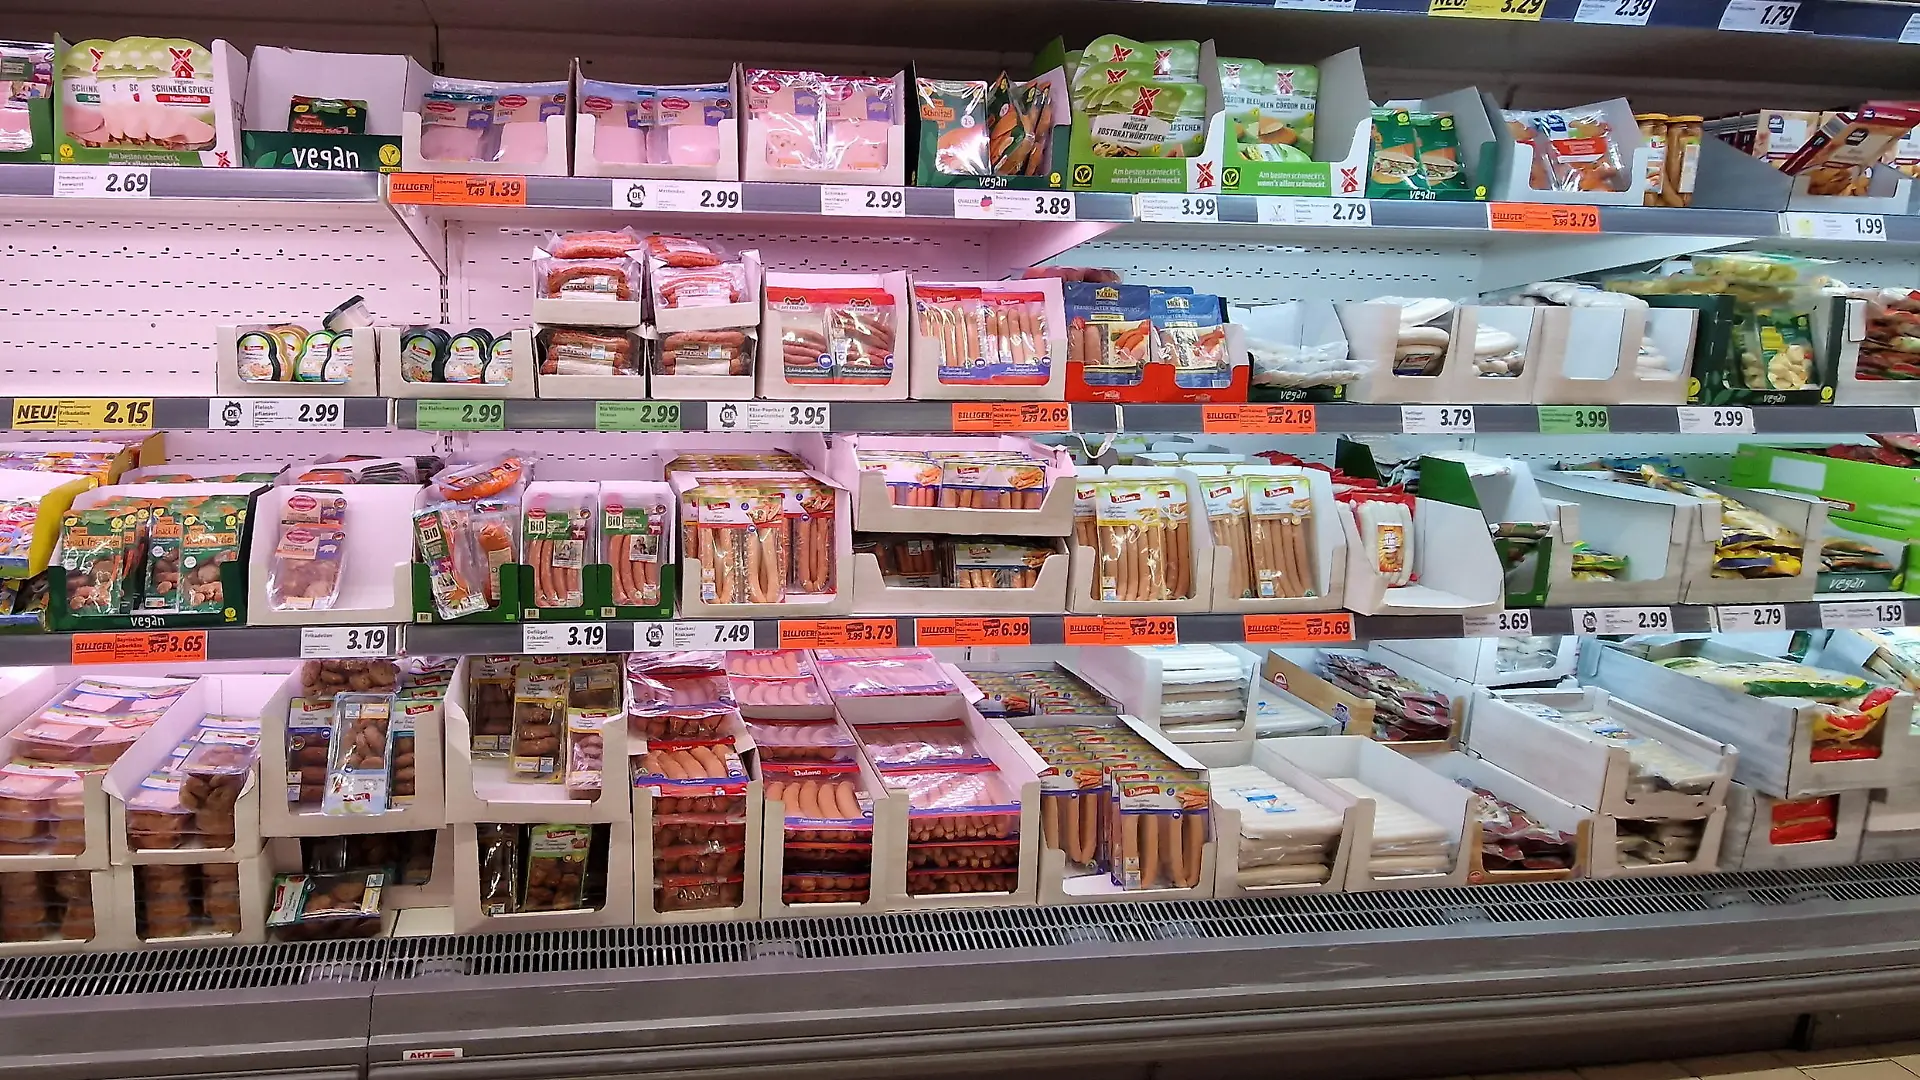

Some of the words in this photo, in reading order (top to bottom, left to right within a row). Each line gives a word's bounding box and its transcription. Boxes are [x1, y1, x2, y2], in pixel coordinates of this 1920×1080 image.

[1501, 0, 1540, 14] 3.29
[1615, 0, 1651, 16] 2.39
[1760, 5, 1796, 25] 1.79
[151, 84, 187, 93] SCHINKEN
[923, 106, 953, 118] Schnitzel
[1123, 120, 1149, 132] MÜHLEN
[292, 146, 359, 170] vegan
[1113, 168, 1123, 176] Am
[105, 173, 149, 193] 2.69
[392, 183, 433, 192] BILLIGER!
[488, 181, 520, 197] 1.39
[978, 176, 1007, 188] vegan
[700, 190, 739, 208] 2.99
[865, 190, 903, 209] 2.99
[1409, 189, 1436, 201] vegan
[1034, 197, 1071, 215] 3.89
[1181, 198, 1216, 215] 3.99
[1333, 203, 1366, 221] 2.79
[1570, 213, 1596, 227] 3.79
[1855, 218, 1883, 234] 1.99
[1281, 389, 1308, 402] vegan
[17, 405, 58, 420] NEU!
[103, 402, 151, 424] 2.15
[227, 410, 237, 418] DE
[298, 404, 339, 422] 2.99
[461, 404, 502, 422] 2.99
[640, 405, 679, 423] 2.99
[789, 406, 827, 425] 3.95
[958, 411, 993, 419] BILLIGER!
[1022, 414, 1038, 423] 2.79
[1040, 408, 1068, 422] 2.69
[1207, 412, 1240, 420] BILLIGER!
[1285, 410, 1312, 424] 2.19
[1440, 409, 1472, 426] 3.79
[1575, 411, 1607, 428] 3.99
[1713, 411, 1743, 426] 2.99
[1829, 577, 1866, 592] vegan
[1499, 613, 1529, 630] 3.69
[1638, 613, 1667, 628] 2.99
[1753, 609, 1781, 625] 2.79
[1876, 605, 1902, 623] 1.59
[130, 616, 165, 628] vegan
[1001, 621, 1029, 637] 6.99
[1070, 624, 1103, 633] BILLIGER!
[1147, 622, 1175, 635] 2.99
[1247, 624, 1280, 633] BILLIGER!
[1323, 621, 1349, 636] 5.69
[567, 626, 604, 646] 3.19
[714, 624, 750, 643] 7.49
[782, 630, 817, 638] BILLIGER!
[864, 625, 893, 640] 3.79
[921, 626, 954, 635] BILLIGER!
[75, 642, 115, 651] BILLIGER!
[169, 635, 203, 652] 3.65
[347, 629, 385, 649] 3.19
[149, 644, 167, 653] 3.79
[793, 769, 822, 777] Dulano
[1128, 787, 1154, 796] Dulano
